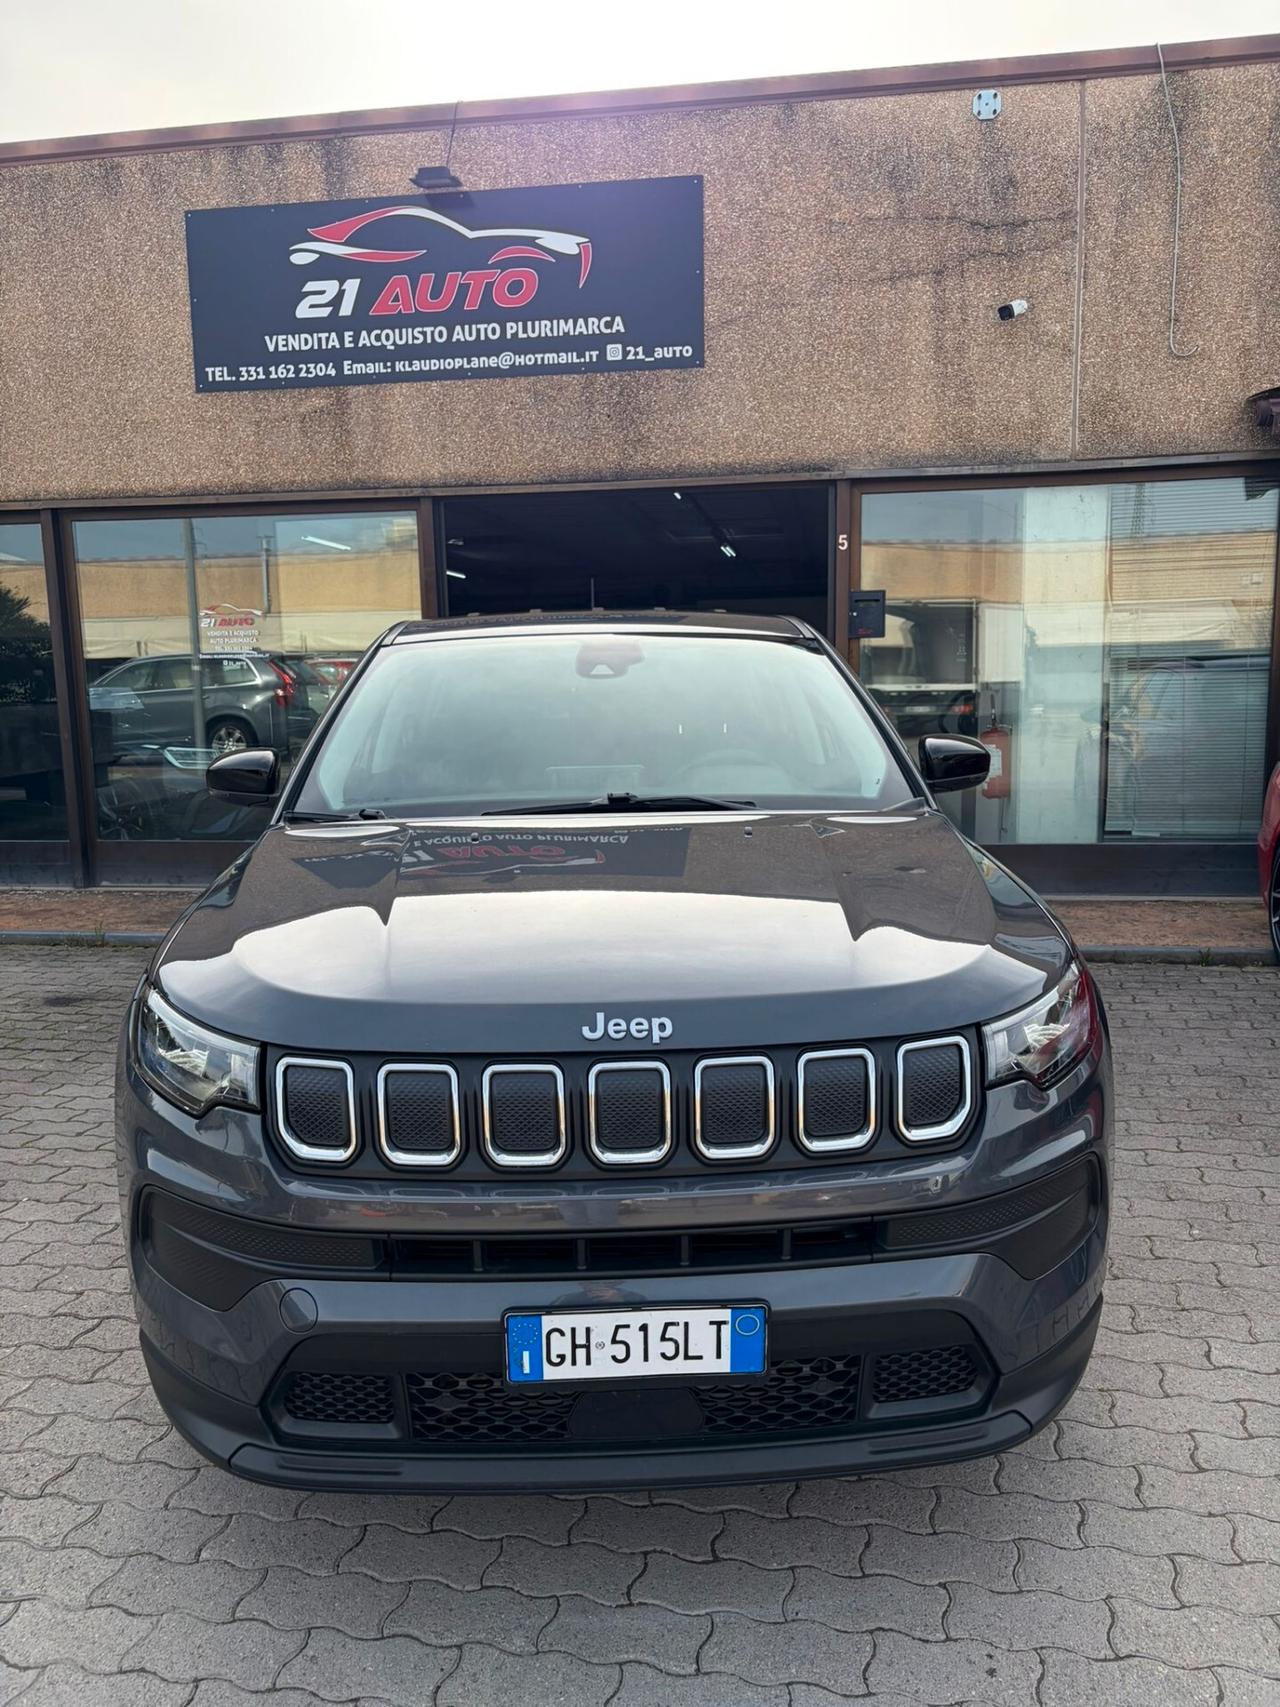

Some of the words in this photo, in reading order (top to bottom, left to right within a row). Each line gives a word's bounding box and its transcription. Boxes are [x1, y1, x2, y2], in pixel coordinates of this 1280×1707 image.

[295, 278, 361, 318] 21
[369, 268, 539, 315] AUTO
[264, 331, 340, 352] VENDITA
[344, 331, 354, 347] E
[357, 326, 448, 350] ACQUISTO
[452, 322, 501, 342] AUTO
[506, 316, 625, 339] PLURIMARCA
[205, 366, 236, 382] TEL.
[239, 365, 266, 380] 331
[269, 364, 295, 379] 162
[298, 362, 336, 377] 2304
[838, 534, 848, 550] 5
[582, 1012, 673, 1044] Jeep
[545, 1326, 592, 1367] GH
[610, 1320, 730, 1364] 515LT
